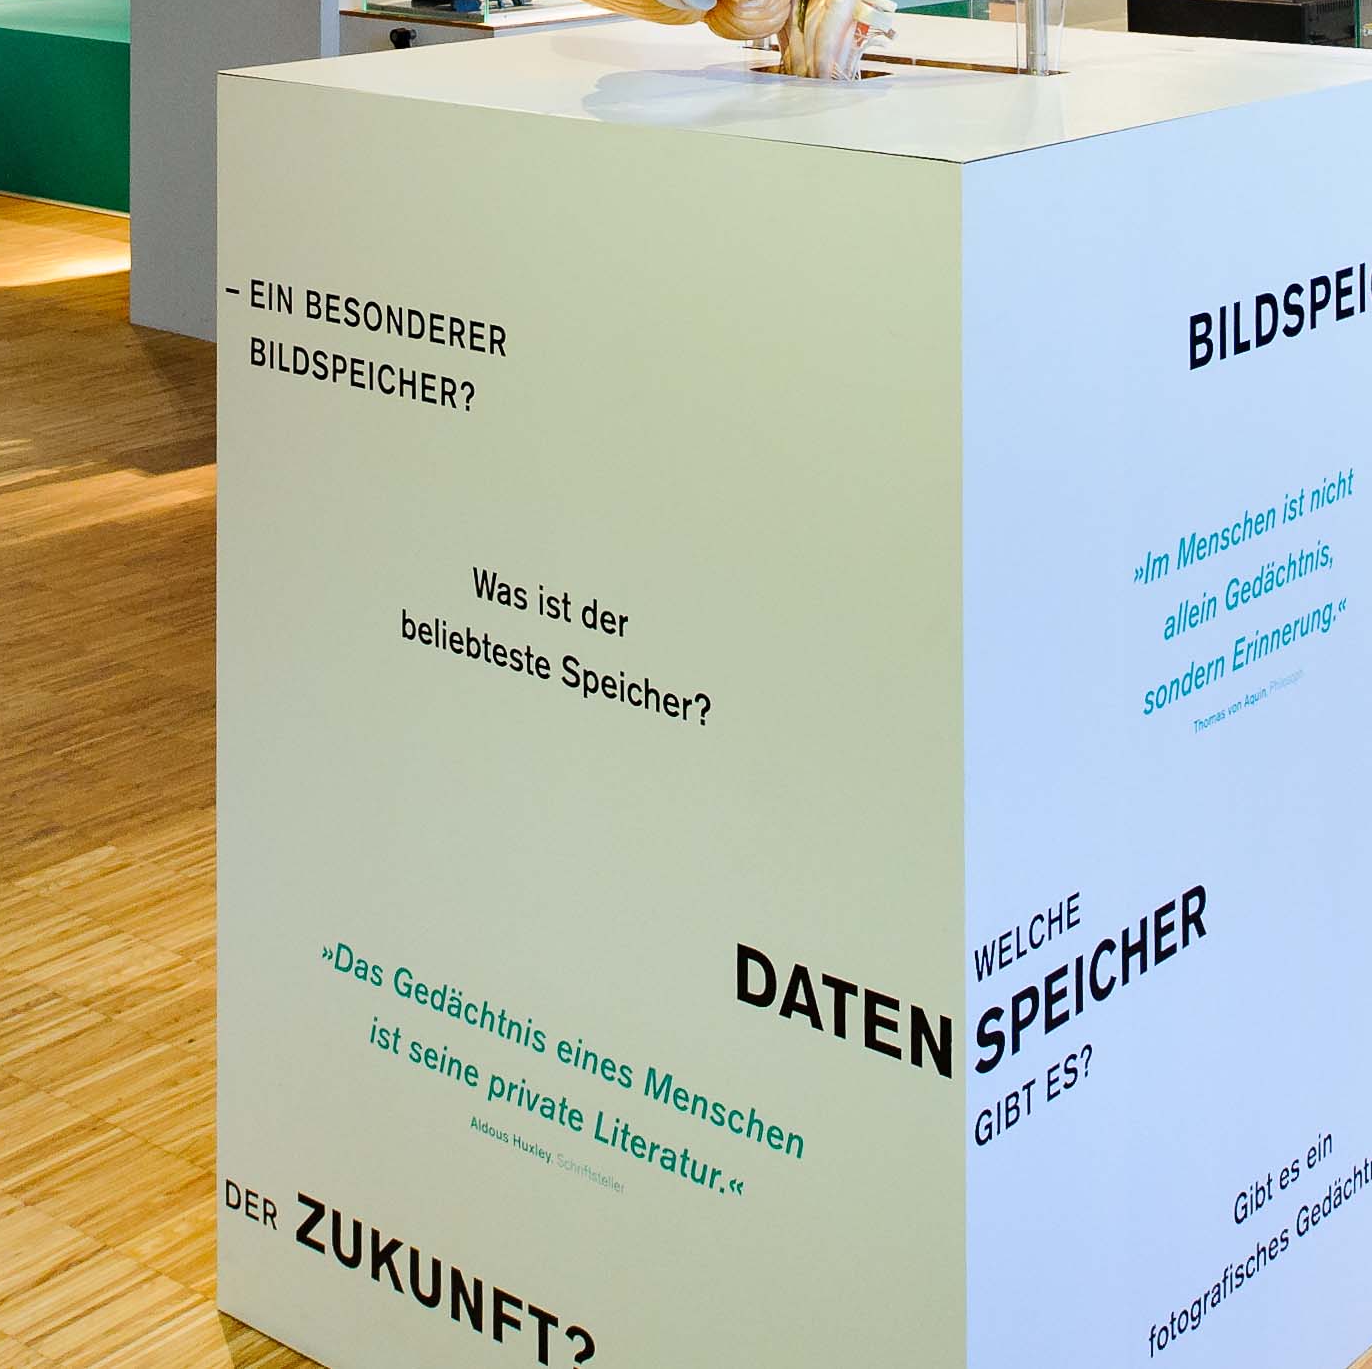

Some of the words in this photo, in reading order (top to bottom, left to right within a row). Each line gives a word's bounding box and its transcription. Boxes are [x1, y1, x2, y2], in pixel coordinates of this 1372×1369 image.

[251, 279, 292, 314] EIN
[306, 289, 506, 357] BESONDERER
[251, 337, 474, 412] BILDSPEICHER?
[1134, 551, 1170, 584] »Im
[1177, 507, 1276, 570] Menschen
[1282, 488, 1305, 524] ist
[1310, 468, 1354, 513] nicht
[473, 566, 527, 610] Was
[539, 584, 571, 623] ist
[582, 599, 628, 637] der
[1164, 592, 1217, 641] allein
[1225, 540, 1333, 611] Gedächtnis,
[402, 609, 551, 679] beliebteste
[561, 655, 711, 726] Speicher?
[1143, 656, 1225, 715] sondern
[1232, 598, 1346, 672] Erinnerung.«
[1193, 709, 1226, 734] Thomas
[1228, 701, 1242, 715] von
[975, 892, 1080, 982] WELCHE
[975, 885, 1207, 1074] SPEICHER
[322, 942, 383, 986] »Das
[394, 967, 546, 1053] Gedächtnis
[557, 1038, 633, 1089] eines
[644, 1067, 803, 1159] Menschen
[737, 943, 952, 1079] DATEN
[370, 1016, 401, 1054] ist
[409, 1041, 479, 1087] seine
[488, 1074, 583, 1132] private
[594, 1111, 743, 1196] Literatur.«
[975, 1078, 1036, 1146] GIBT
[1047, 1044, 1092, 1102] ES?
[471, 1117, 508, 1143] Aldous
[557, 1153, 625, 1194] Schriftsteller
[1234, 1172, 1273, 1225] Gibt
[1280, 1159, 1300, 1190] es
[1307, 1134, 1332, 1169] ein
[226, 1179, 277, 1230] DER
[296, 1191, 595, 1369] ZUKUNFT?
[1149, 1229, 1289, 1358] fotografisches
